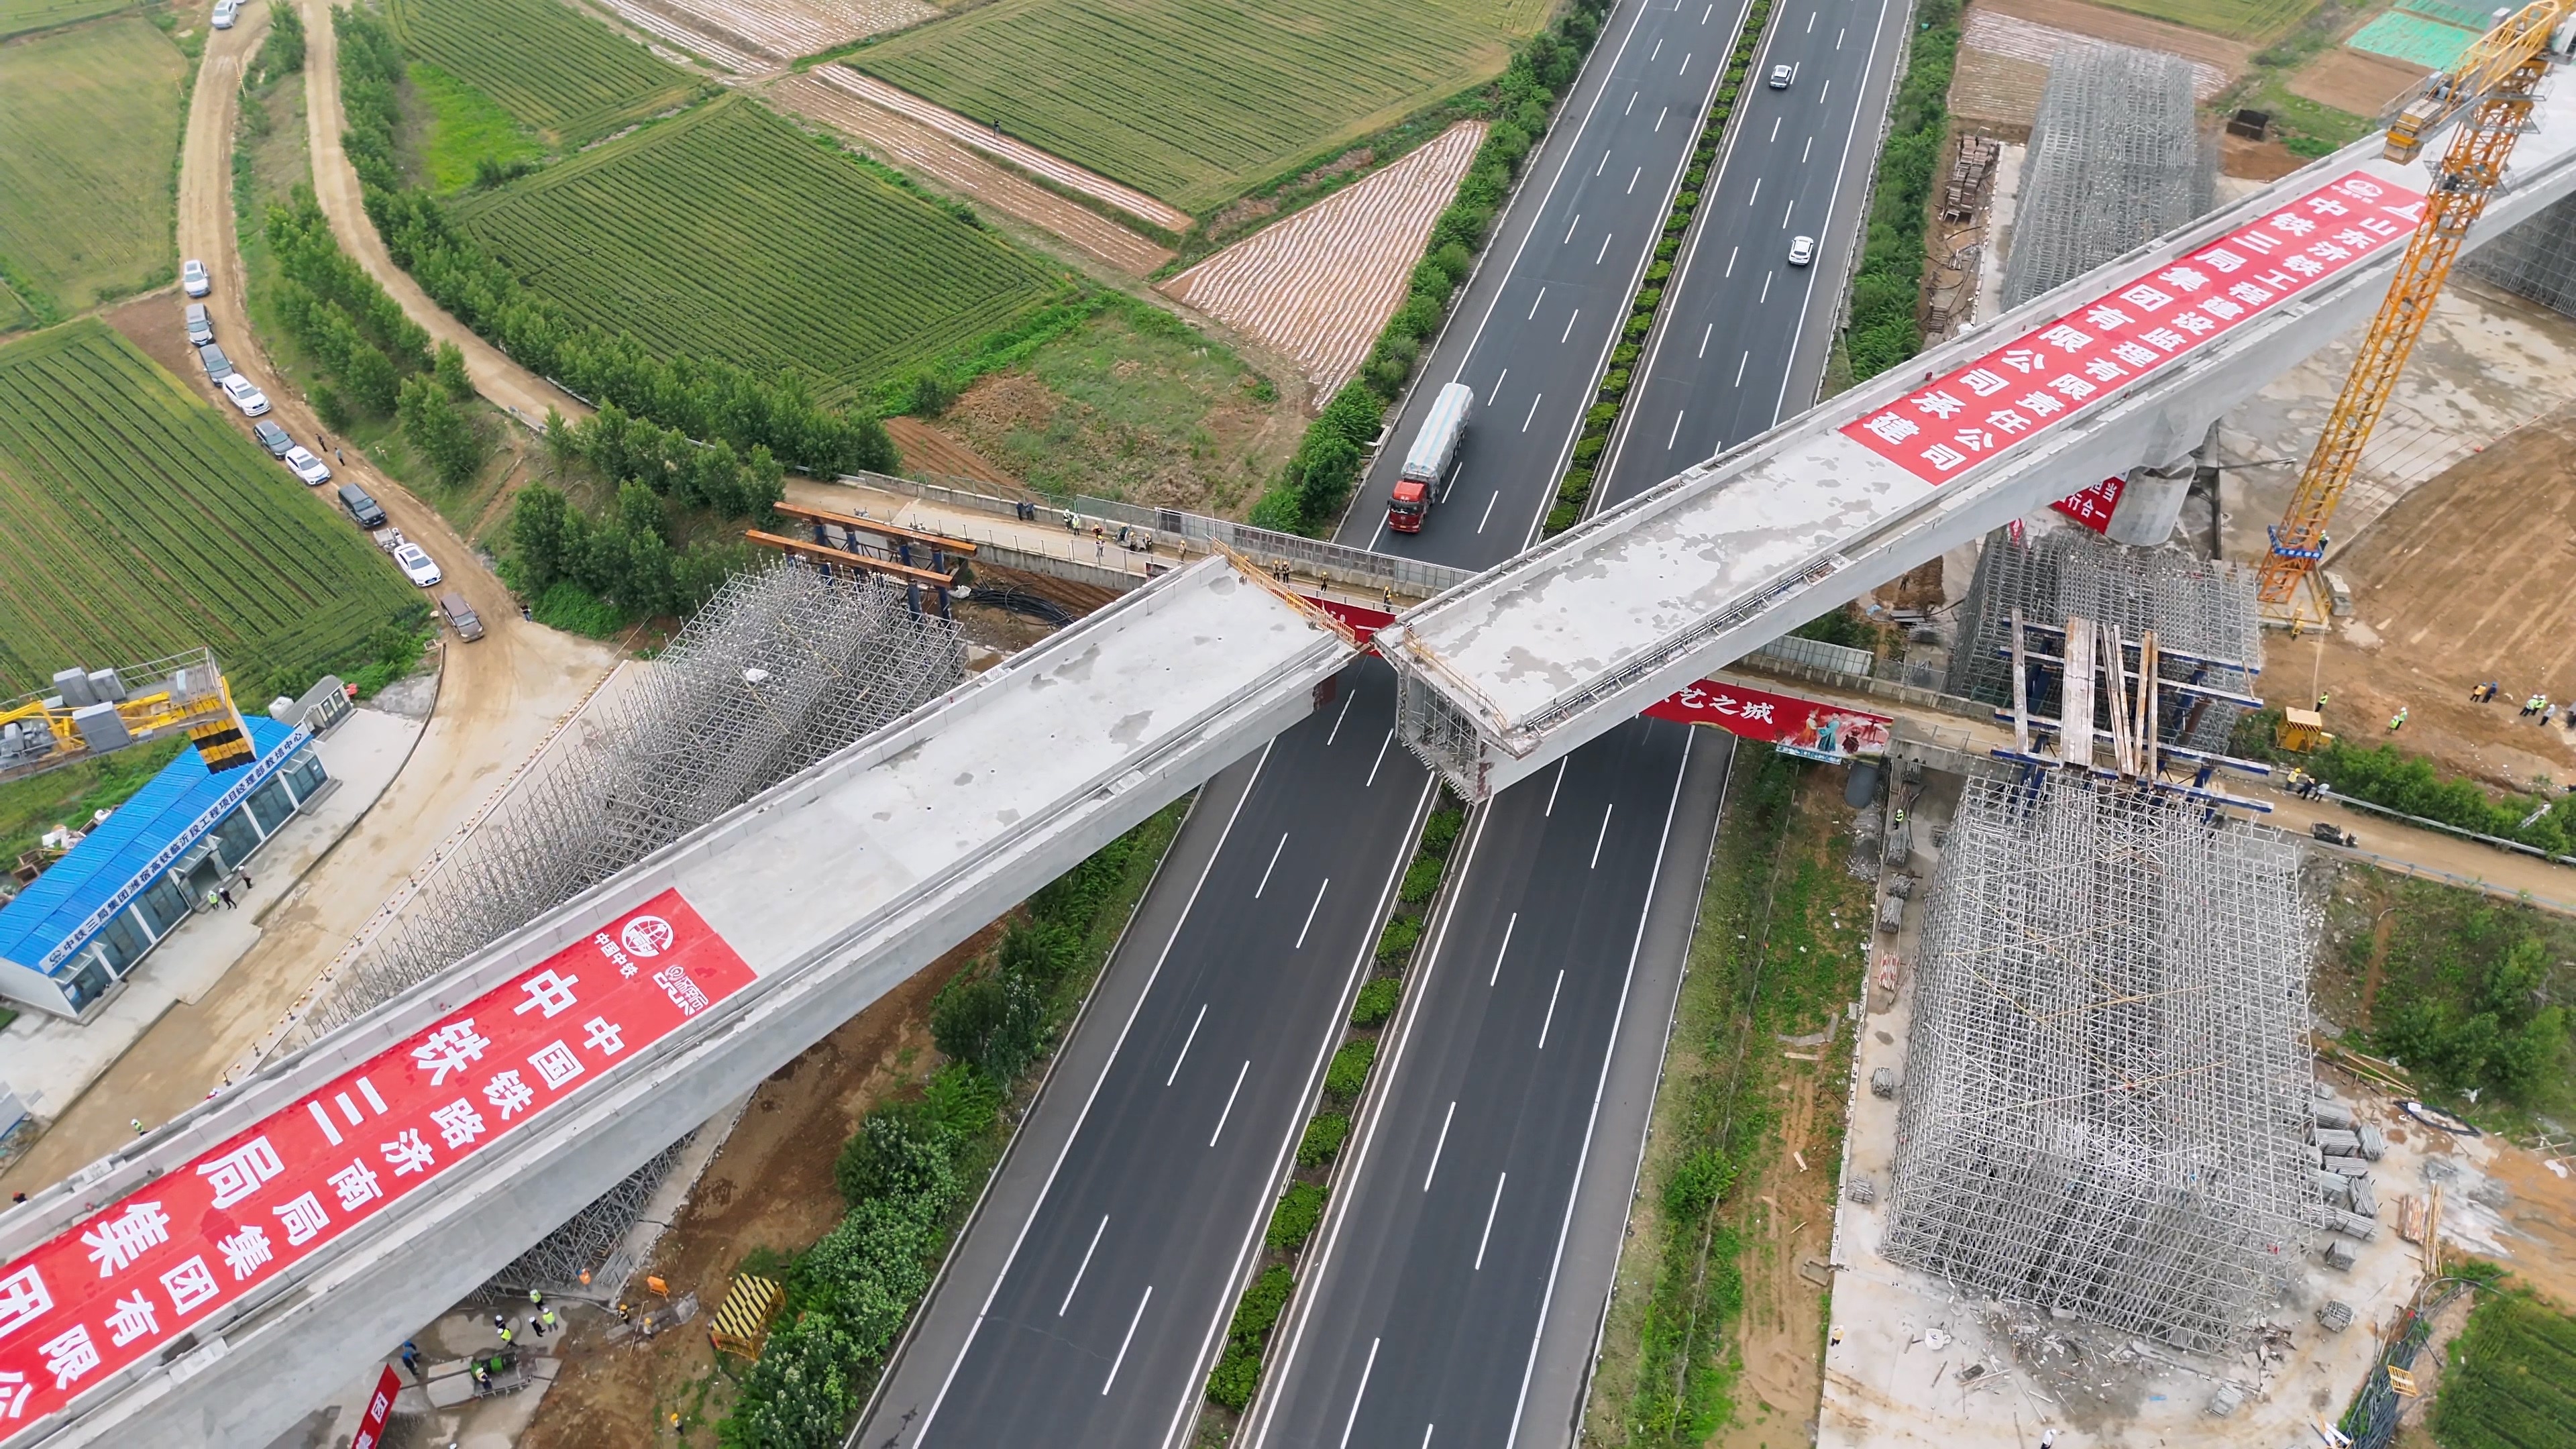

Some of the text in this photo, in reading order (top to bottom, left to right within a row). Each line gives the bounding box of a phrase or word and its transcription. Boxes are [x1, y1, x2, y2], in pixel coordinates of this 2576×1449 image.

[1863, 197, 2349, 445] 中铁三局集团有限公司承建
[1921, 217, 2398, 471] 山东济铁工程建设监理有限责任公司
[2059, 493, 2107, 519] 行合一
[1664, 686, 1774, 724] 艺之城
[64, 732, 302, 951] 中铁三局集团潍宿高铁临沂段工程项目经理部教培中心
[594, 932, 639, 979] 中国中铁
[0, 969, 580, 1340] 中铁三局集团
